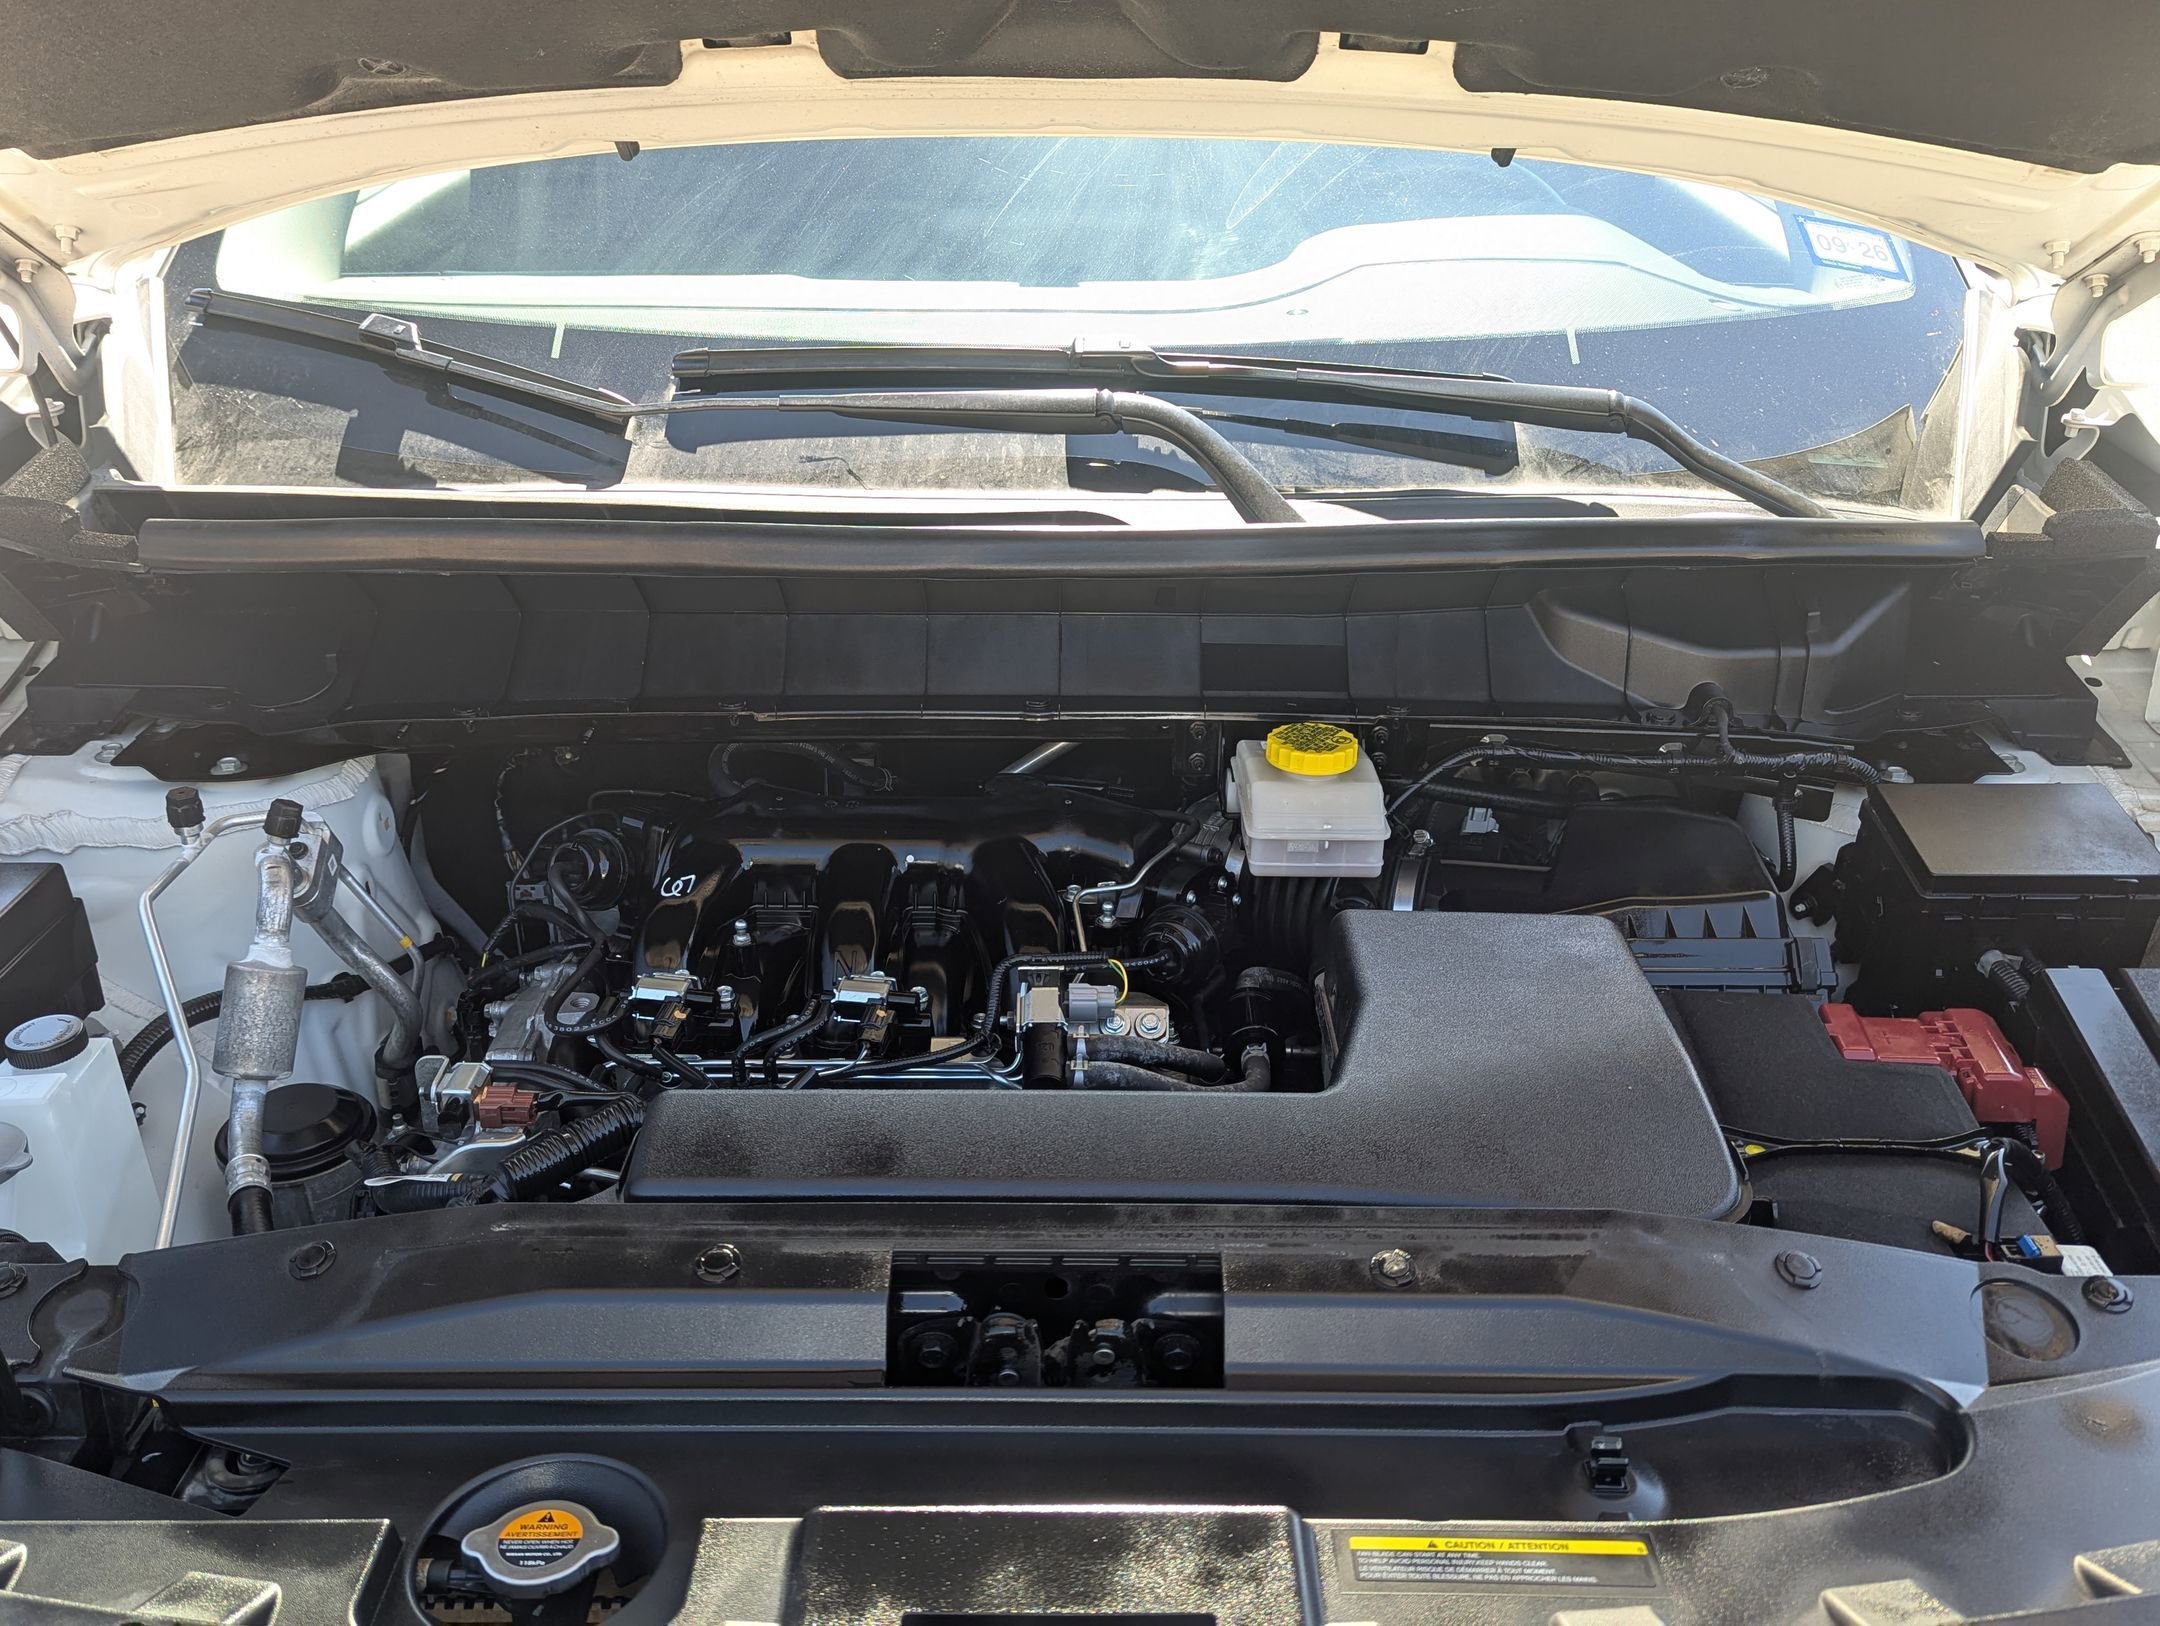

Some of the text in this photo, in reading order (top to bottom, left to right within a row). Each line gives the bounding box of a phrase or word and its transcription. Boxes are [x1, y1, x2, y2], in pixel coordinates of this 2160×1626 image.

[1816, 233, 1889, 262] 09 26
[1445, 1541, 1495, 1549] CAUTION
[1508, 1543, 1569, 1551] ATTENTION
